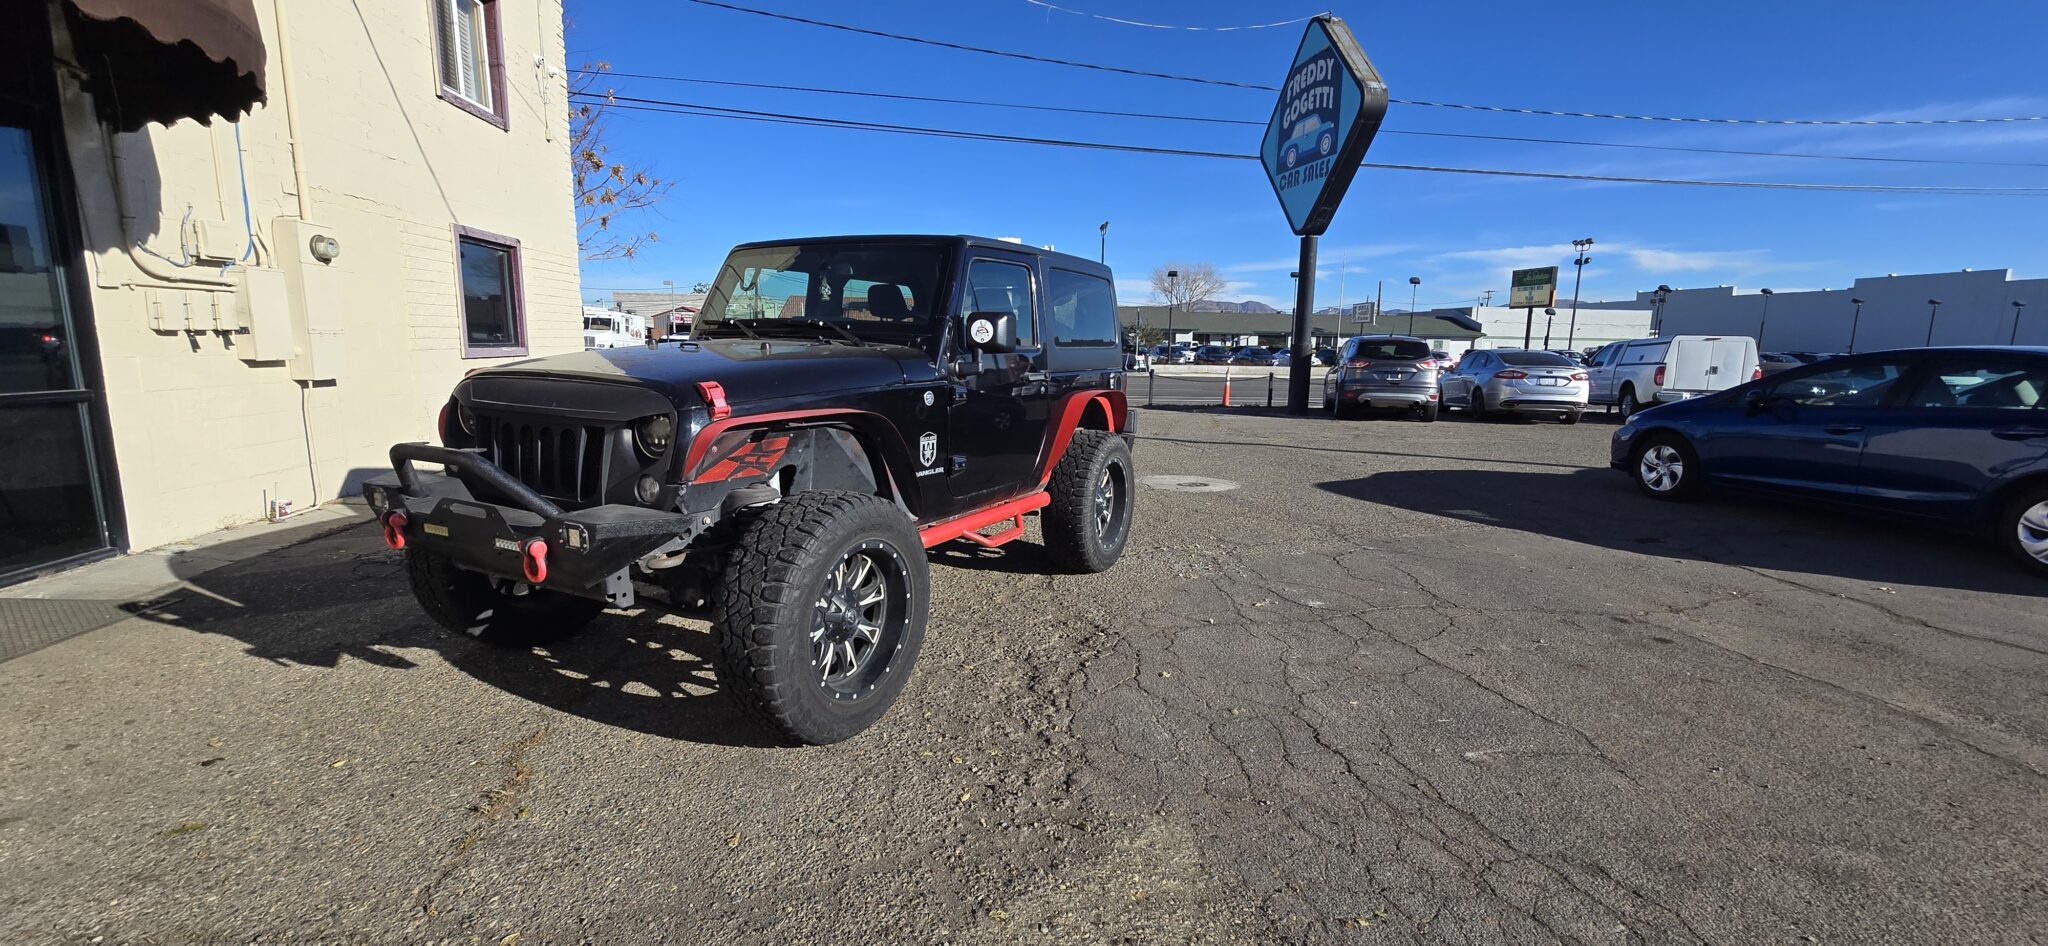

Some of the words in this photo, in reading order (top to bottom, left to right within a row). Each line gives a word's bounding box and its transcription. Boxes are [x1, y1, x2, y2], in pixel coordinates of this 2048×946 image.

[1286, 58, 1334, 103] FREDDY
[1283, 86, 1333, 129] GOGETTI
[1279, 170, 1300, 191] CAR
[1302, 158, 1331, 184] SALES
